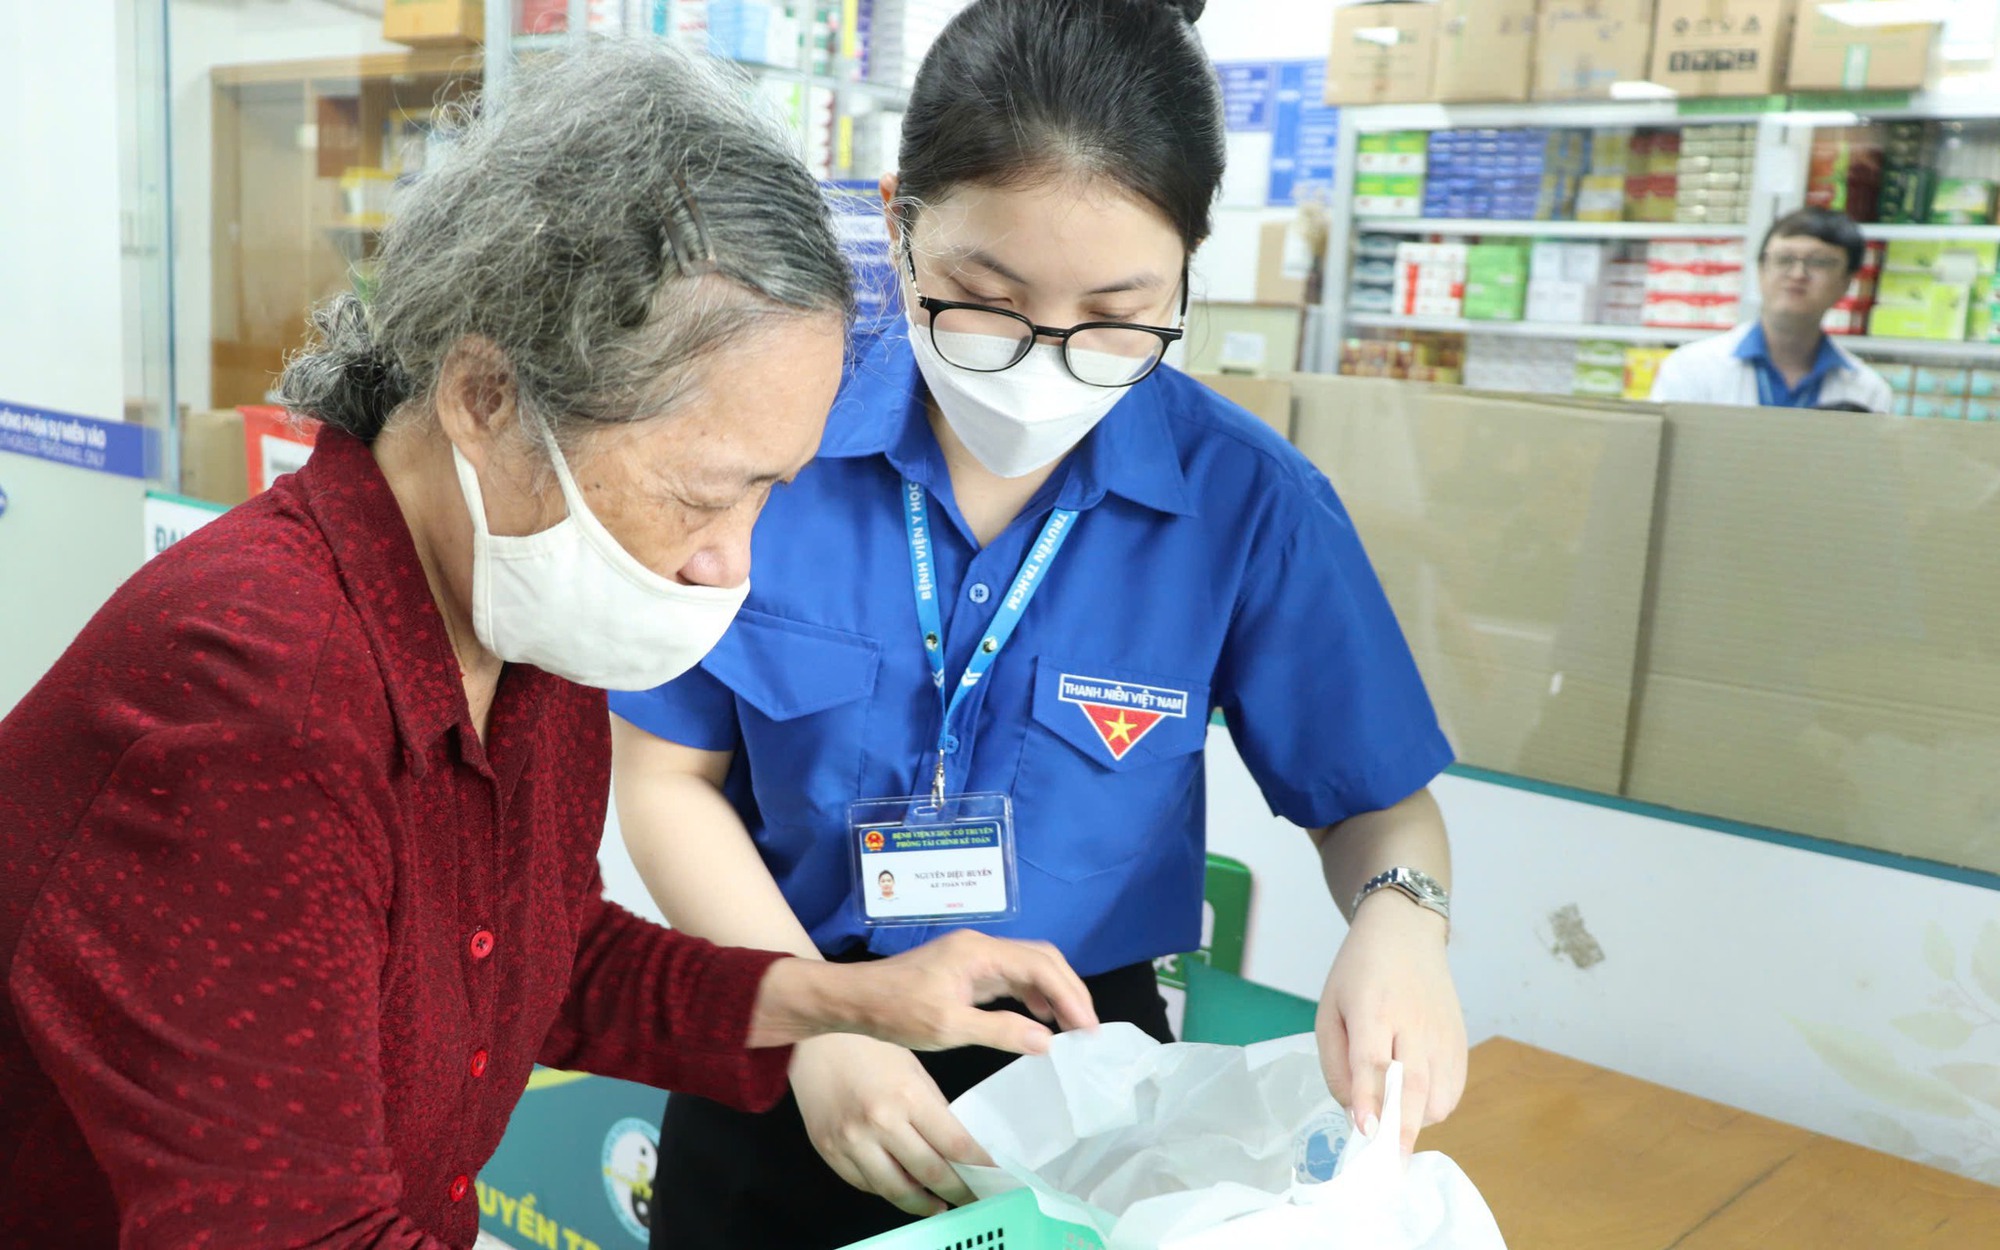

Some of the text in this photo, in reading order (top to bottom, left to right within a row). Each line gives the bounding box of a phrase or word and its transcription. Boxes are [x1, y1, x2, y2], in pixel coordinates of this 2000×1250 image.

[908, 482, 933, 600] BỆNH VIỆN Y HỌC
[1006, 563, 1040, 611] TP.HCM
[1064, 682, 1182, 710] THANH NIÊN VIỆT NAM
[474, 1180, 558, 1250] UYỀN
